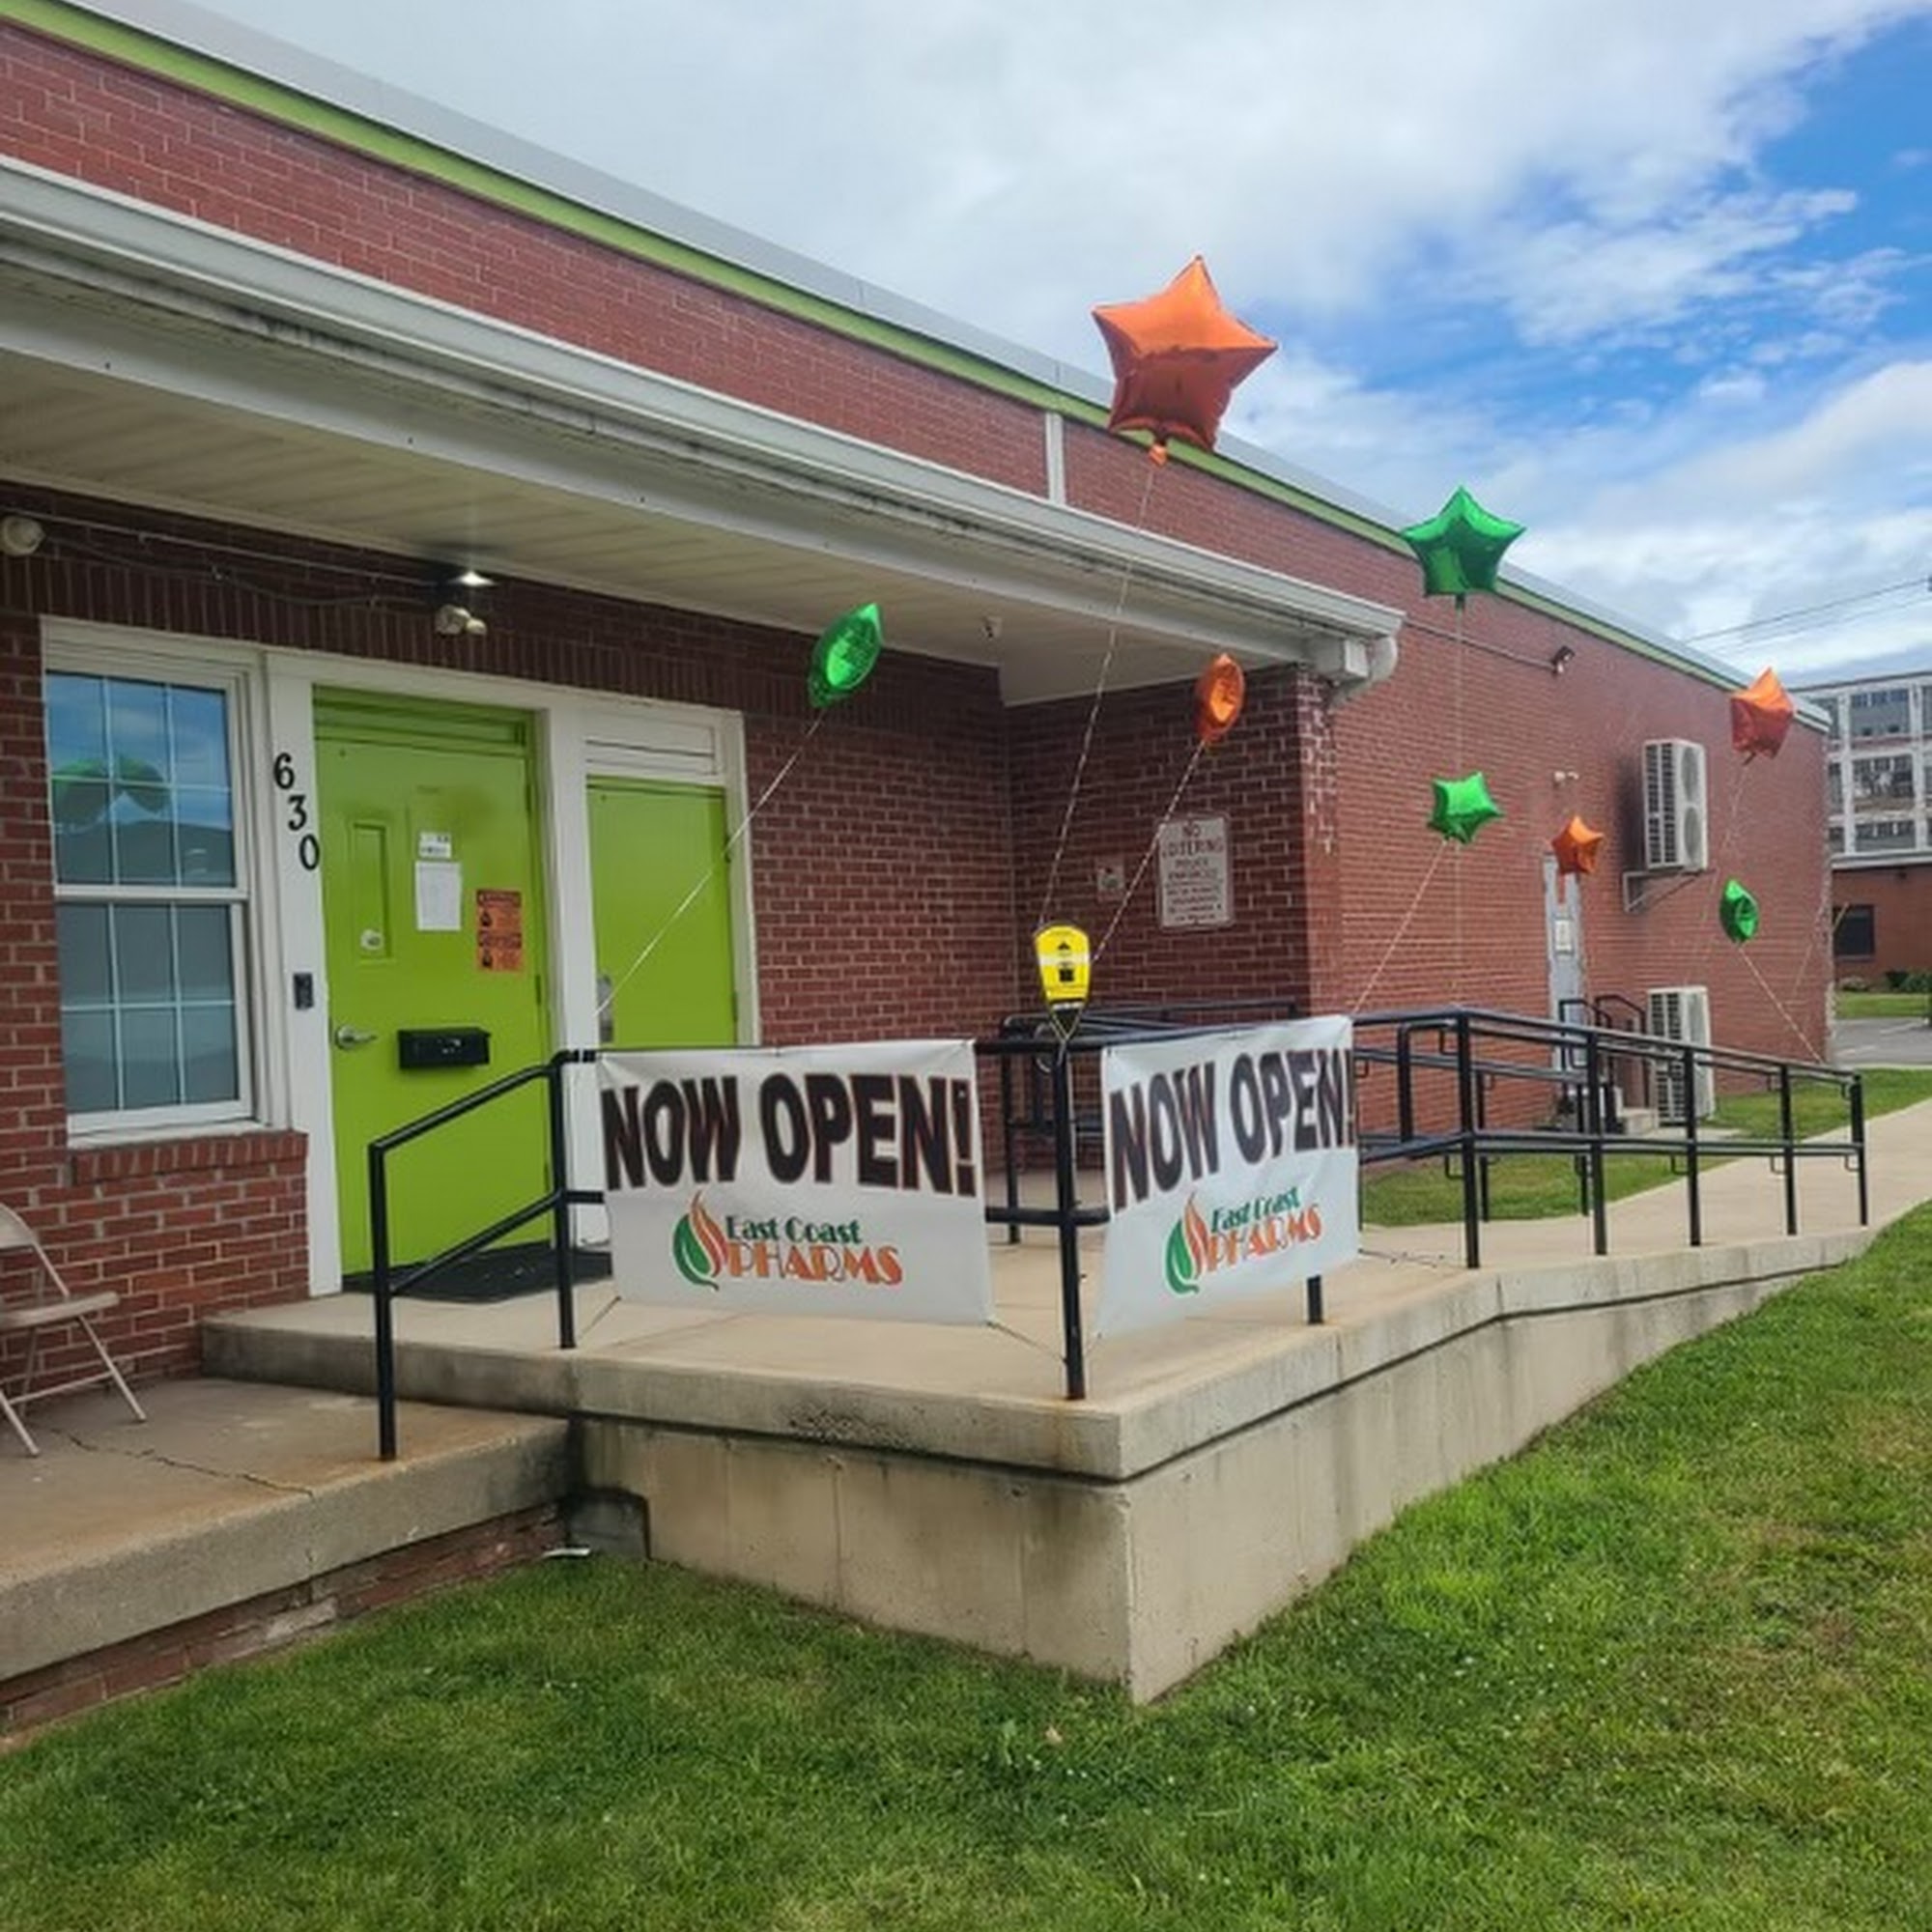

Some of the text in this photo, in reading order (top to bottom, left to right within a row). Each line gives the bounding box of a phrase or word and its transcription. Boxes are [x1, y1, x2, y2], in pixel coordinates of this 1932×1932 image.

[273, 752, 320, 871] 630
[601, 1073, 977, 1197] NOW OPEN!
[1110, 1048, 1354, 1214] NOW OPEN!
[725, 1241, 902, 1286] PHARMS
[726, 1216, 861, 1244] East Coast
[1207, 1204, 1321, 1272] PHARMS
